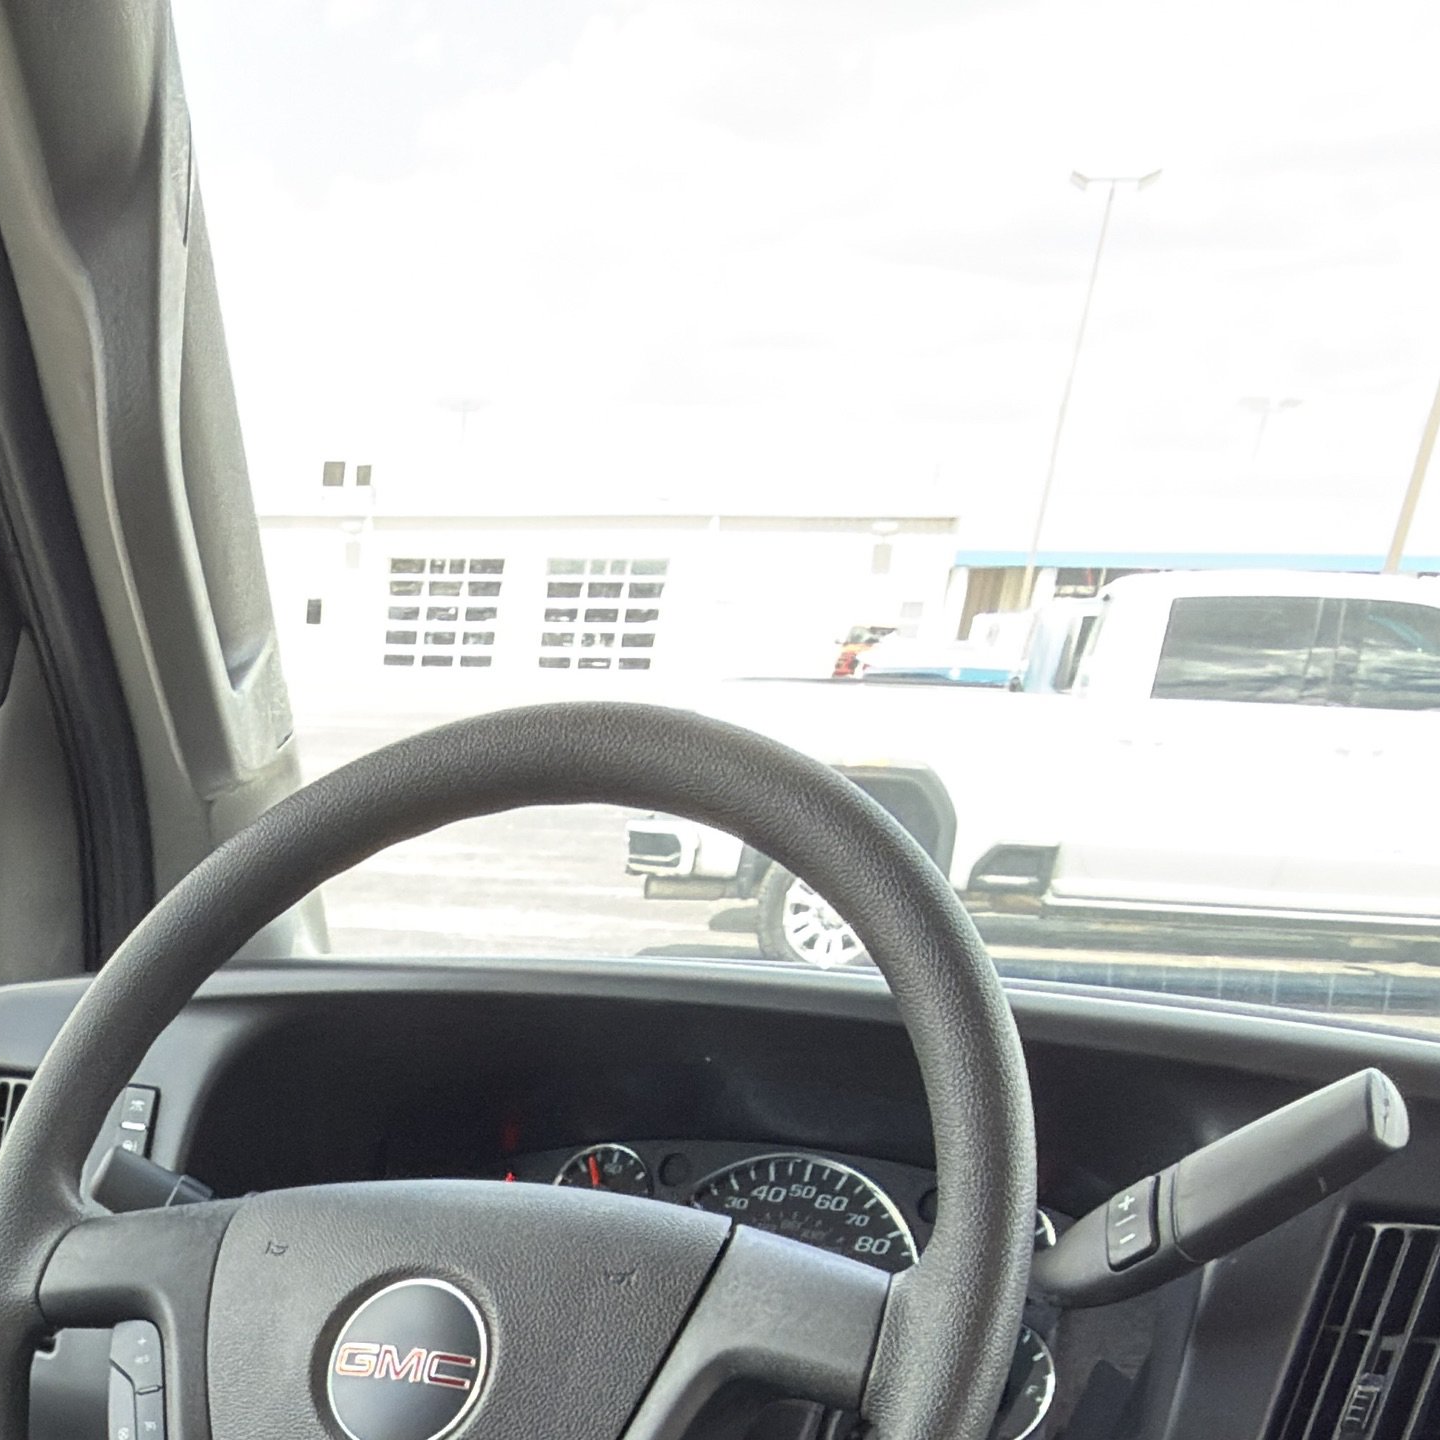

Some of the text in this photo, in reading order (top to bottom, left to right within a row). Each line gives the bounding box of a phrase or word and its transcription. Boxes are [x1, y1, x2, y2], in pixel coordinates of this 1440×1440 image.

[751, 1184, 788, 1203] 40
[788, 1184, 817, 1199] 50
[724, 1196, 749, 1211] 30
[814, 1195, 849, 1213] 60
[845, 1213, 870, 1228] 70
[854, 1236, 892, 1256] 80
[335, 1342, 477, 1390] GMC
